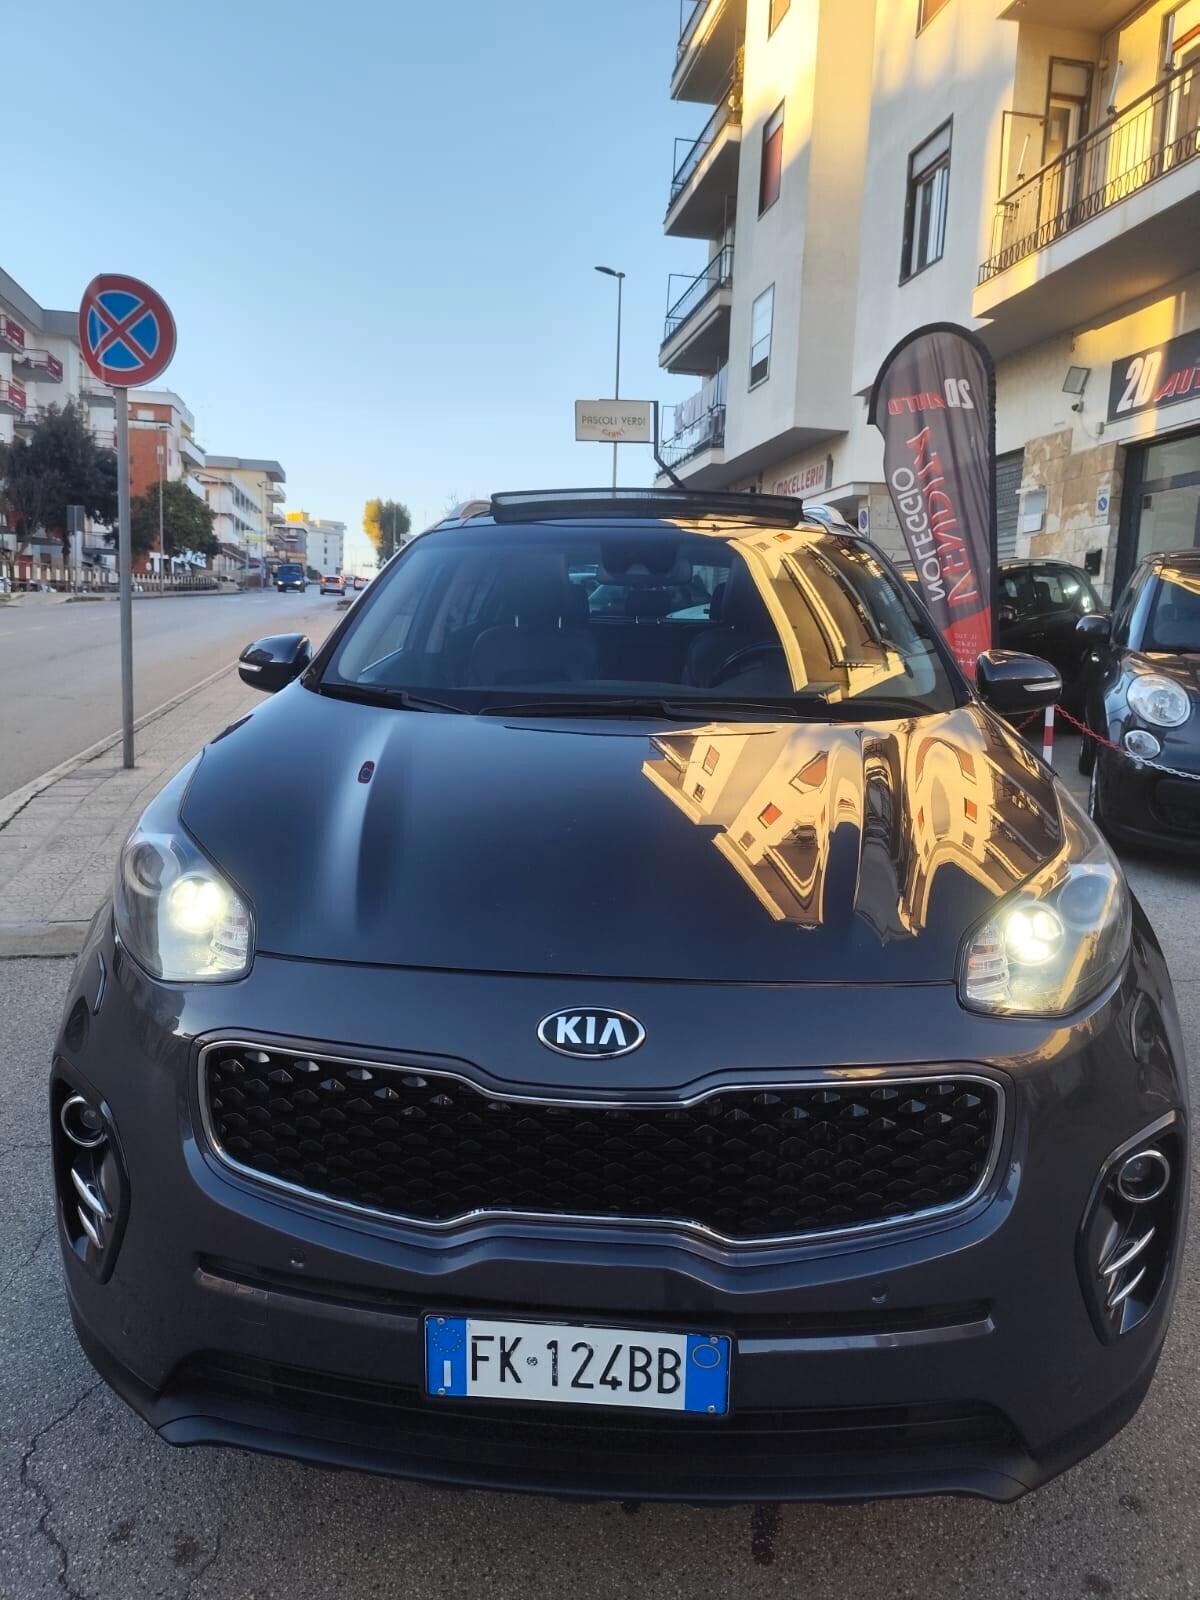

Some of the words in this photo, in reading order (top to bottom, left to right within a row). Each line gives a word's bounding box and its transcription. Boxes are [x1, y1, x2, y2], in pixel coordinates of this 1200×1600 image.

[1116, 351, 1162, 413] 2D
[581, 415, 618, 425] PASCOLI
[621, 415, 646, 426] VERDI
[556, 1016, 627, 1046] KIA
